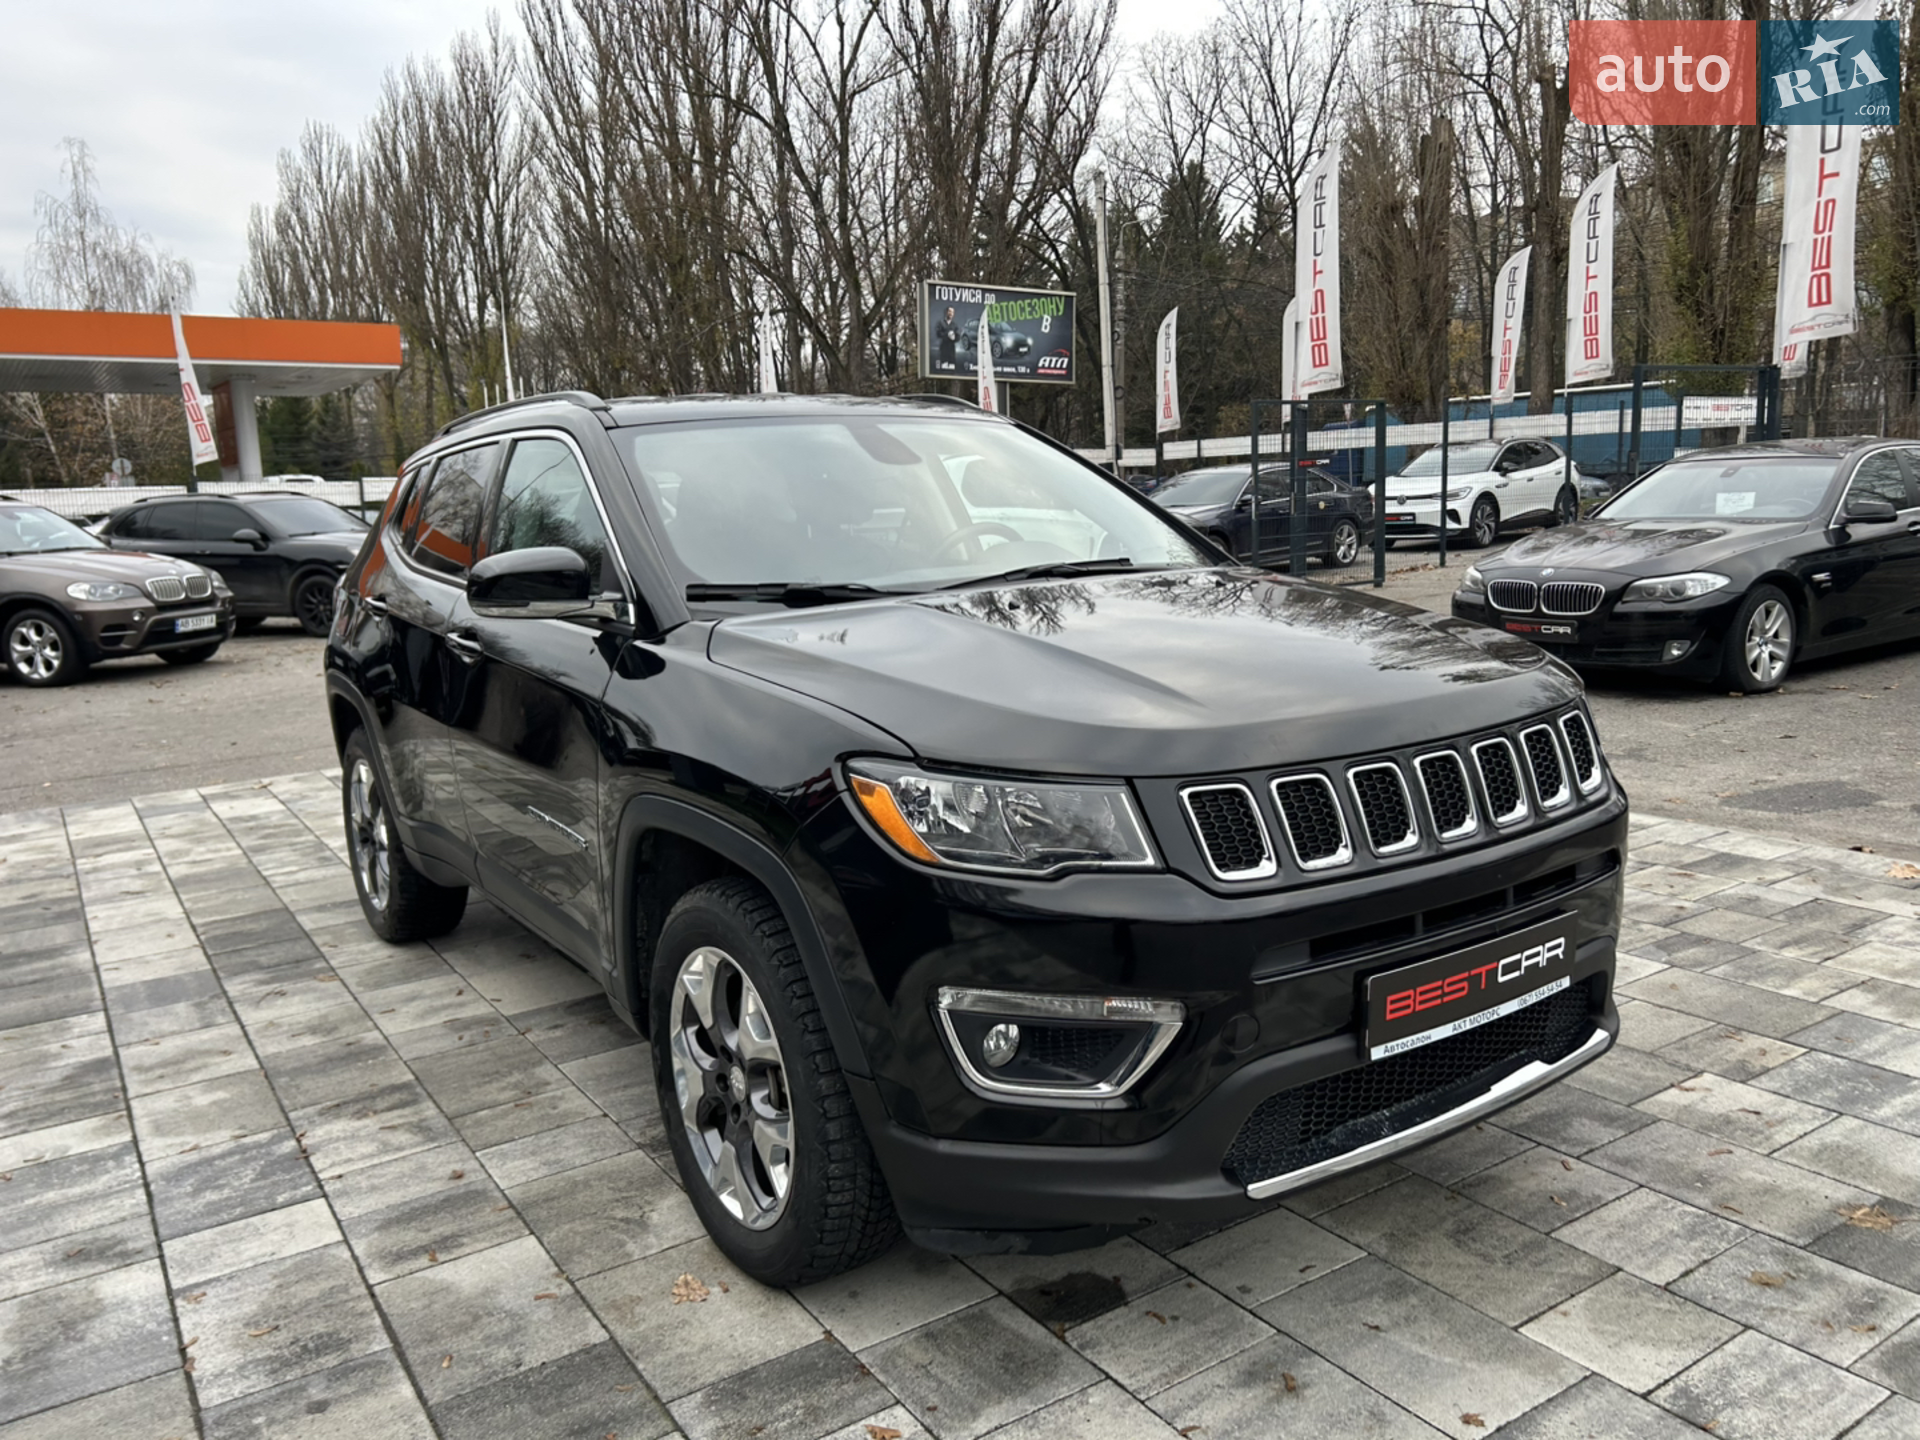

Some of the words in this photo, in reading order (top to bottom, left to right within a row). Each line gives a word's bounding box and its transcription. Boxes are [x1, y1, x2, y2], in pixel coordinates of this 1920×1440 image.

[1310, 173, 1330, 368] BESTCAR
[1583, 192, 1602, 360] BESTCAR
[986, 296, 1065, 324] АВТОСЕЗОНУ
[1498, 266, 1519, 390] BESTCAR
[1038, 356, 1069, 369] АТЛ
[1505, 623, 1572, 635] BESTCAR
[1386, 936, 1566, 1021] BESTCAR
[1383, 1033, 1432, 1055] Автосалон
[1451, 1017, 1468, 1033] АКТ
[1469, 1008, 1501, 1027] МОТОРС
